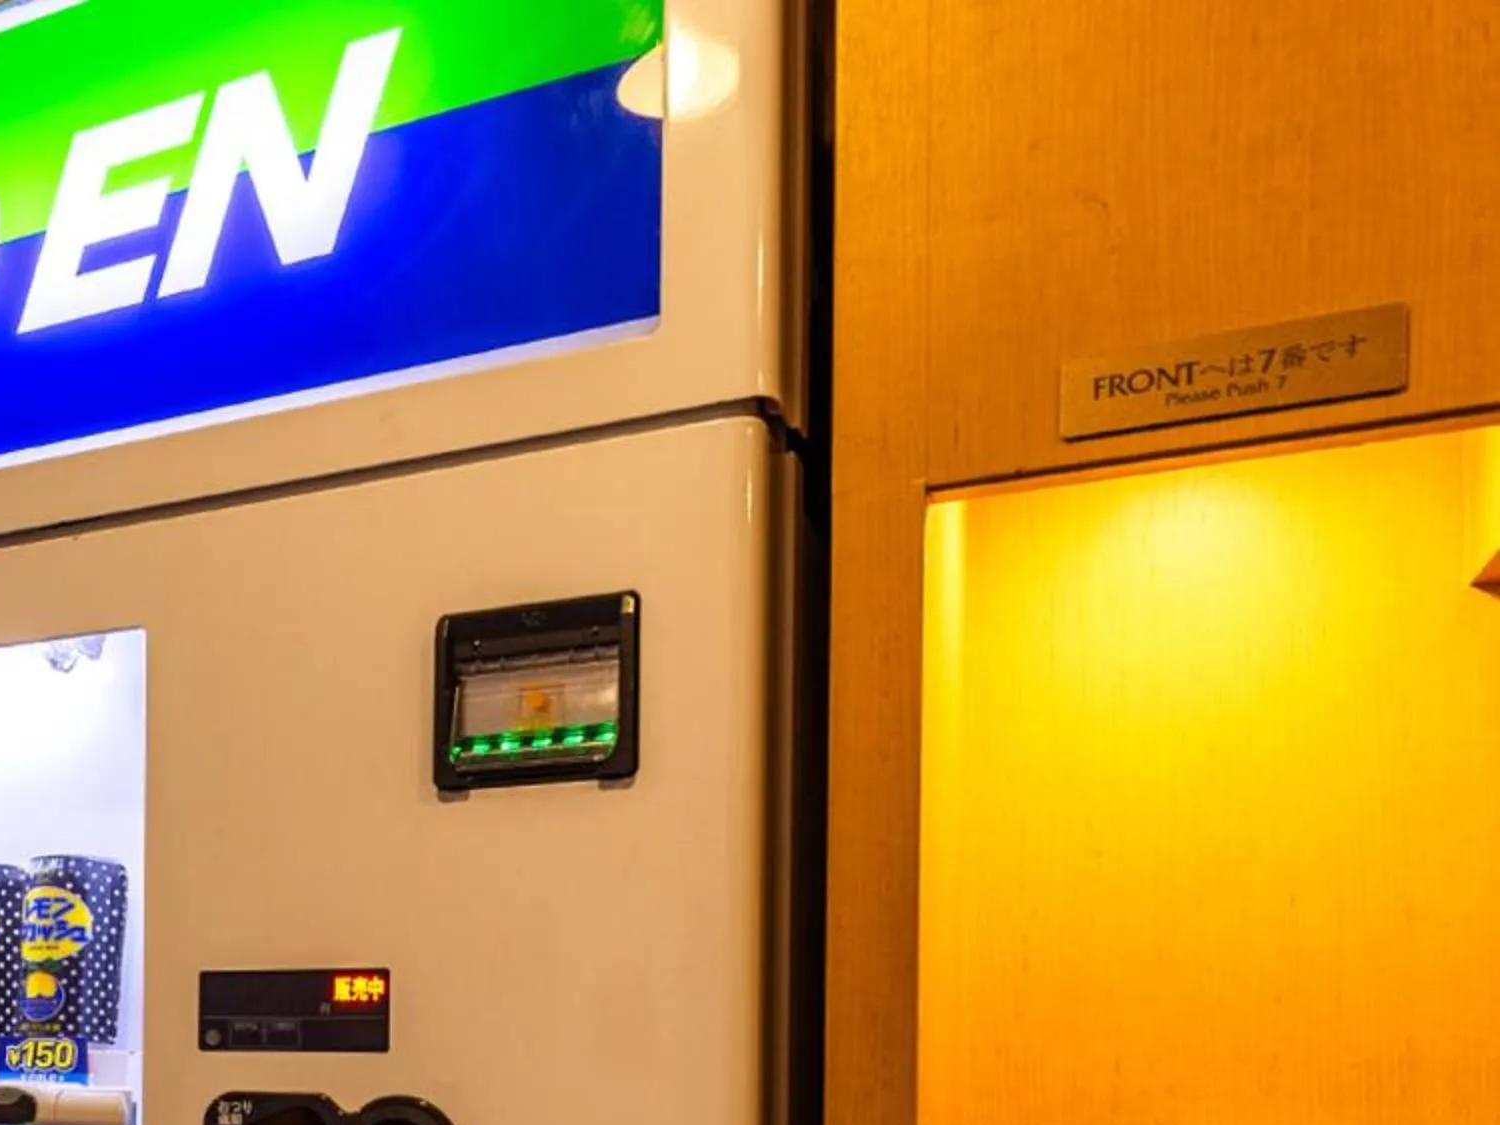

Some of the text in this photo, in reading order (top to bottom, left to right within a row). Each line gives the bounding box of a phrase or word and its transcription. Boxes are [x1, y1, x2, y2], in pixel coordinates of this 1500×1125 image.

[16, 26, 403, 335] EN
[1165, 375, 1288, 406] Please Push 7
[7, 1039, 74, 1070] ¥150
